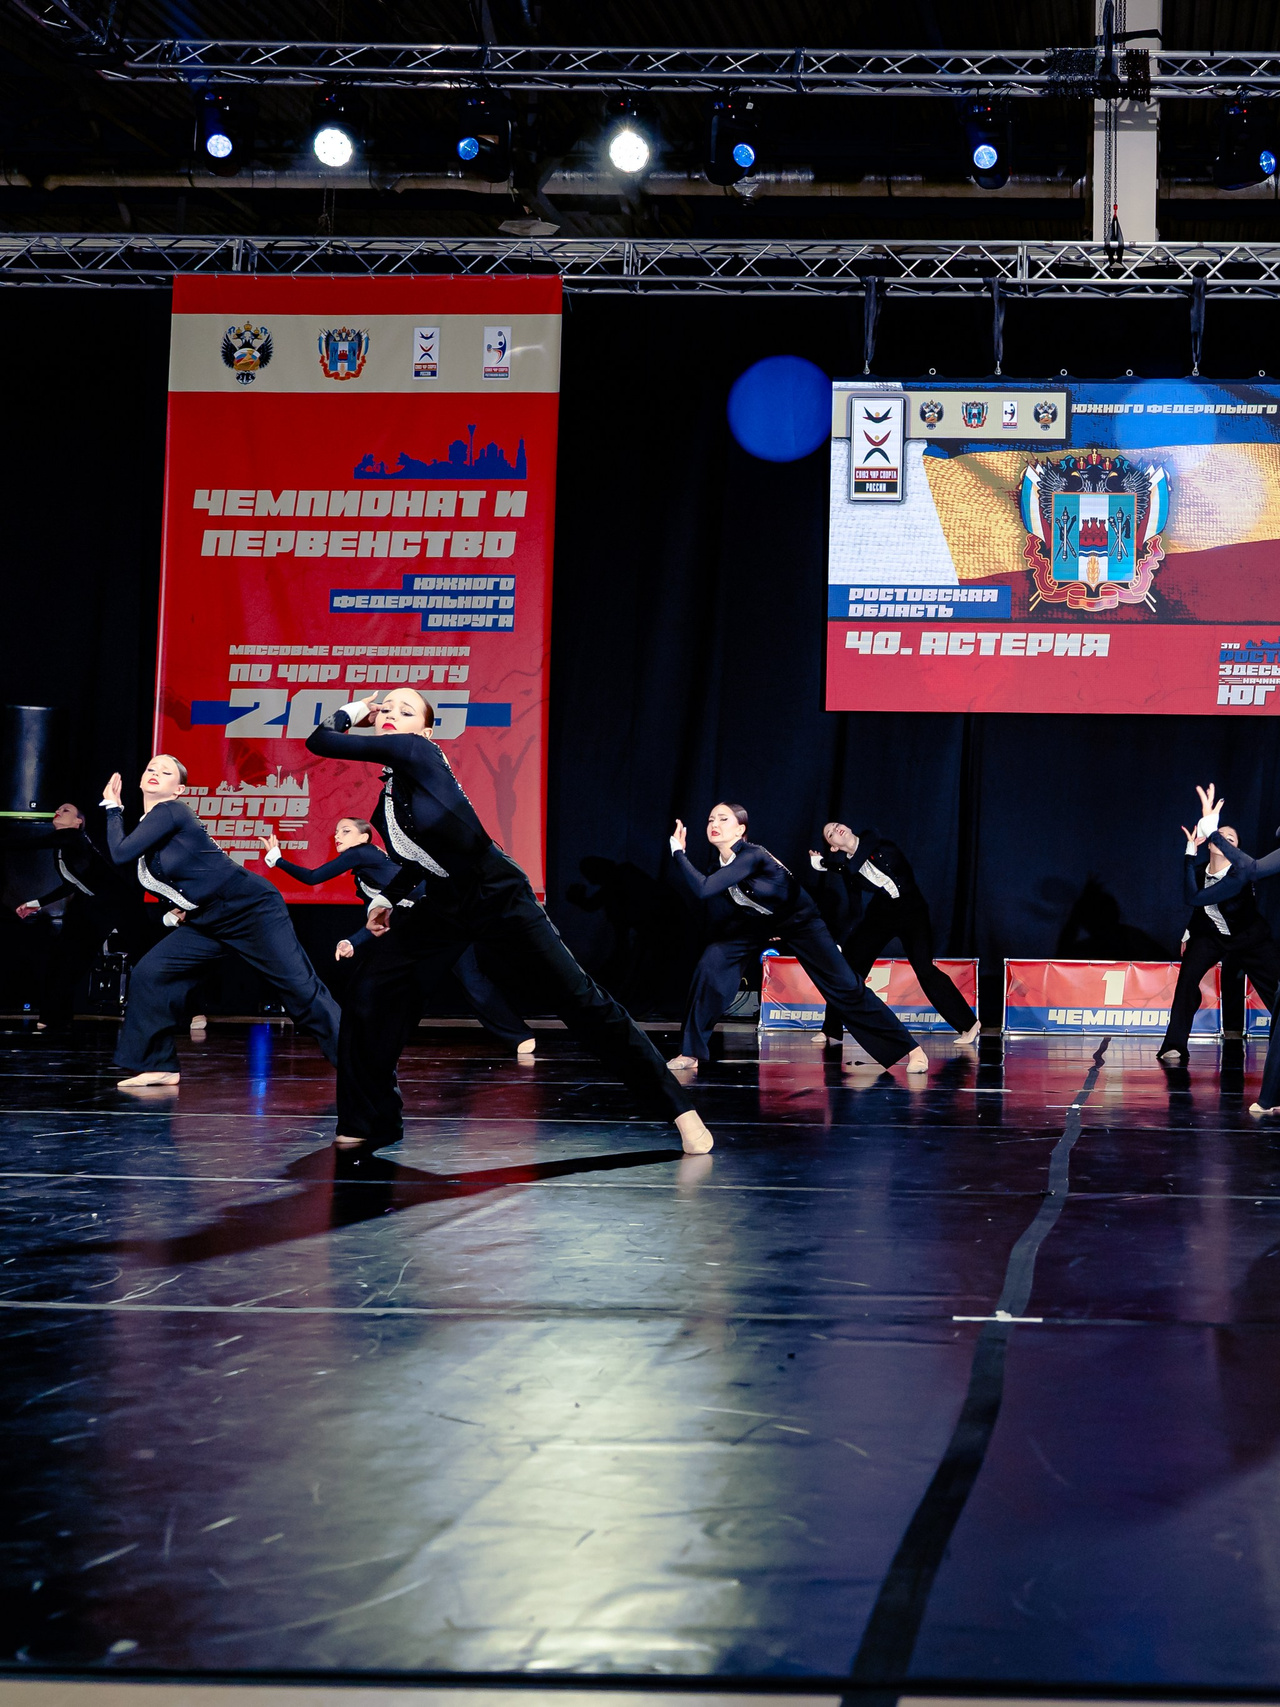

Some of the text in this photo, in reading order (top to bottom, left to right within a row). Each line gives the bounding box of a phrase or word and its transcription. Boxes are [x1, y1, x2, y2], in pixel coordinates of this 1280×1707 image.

[1071, 404, 1144, 414] ЮЖНОГО
[1146, 404, 1278, 414] ФЕДЕРАЛЬНОГО
[193, 489, 528, 517] ЧЕМПИОНАТ И
[200, 530, 517, 558] ПЕРВЕНСТВО
[413, 577, 515, 591] ЮЖНОГО
[332, 595, 515, 610] ФЕДЕРАЛЬНОГО
[848, 587, 999, 603] РОСТОВСКАЯ
[848, 604, 954, 618] ОБЛАСТЬ
[427, 613, 514, 628] ОКРУГА
[229, 644, 471, 658] МАССОВЫЕ СОРЕВНОВАНИЯ
[919, 631, 1111, 658] АСТЕРИЯ
[1221, 642, 1241, 650] ЭТО
[228, 663, 470, 684] ПО ЧИР СПОРТУ
[1216, 685, 1276, 706] ЮГ
[202, 819, 274, 837] ДЕСЬ
[1101, 970, 1126, 1006] 1
[769, 1009, 826, 1022] ПЕРВЫ
